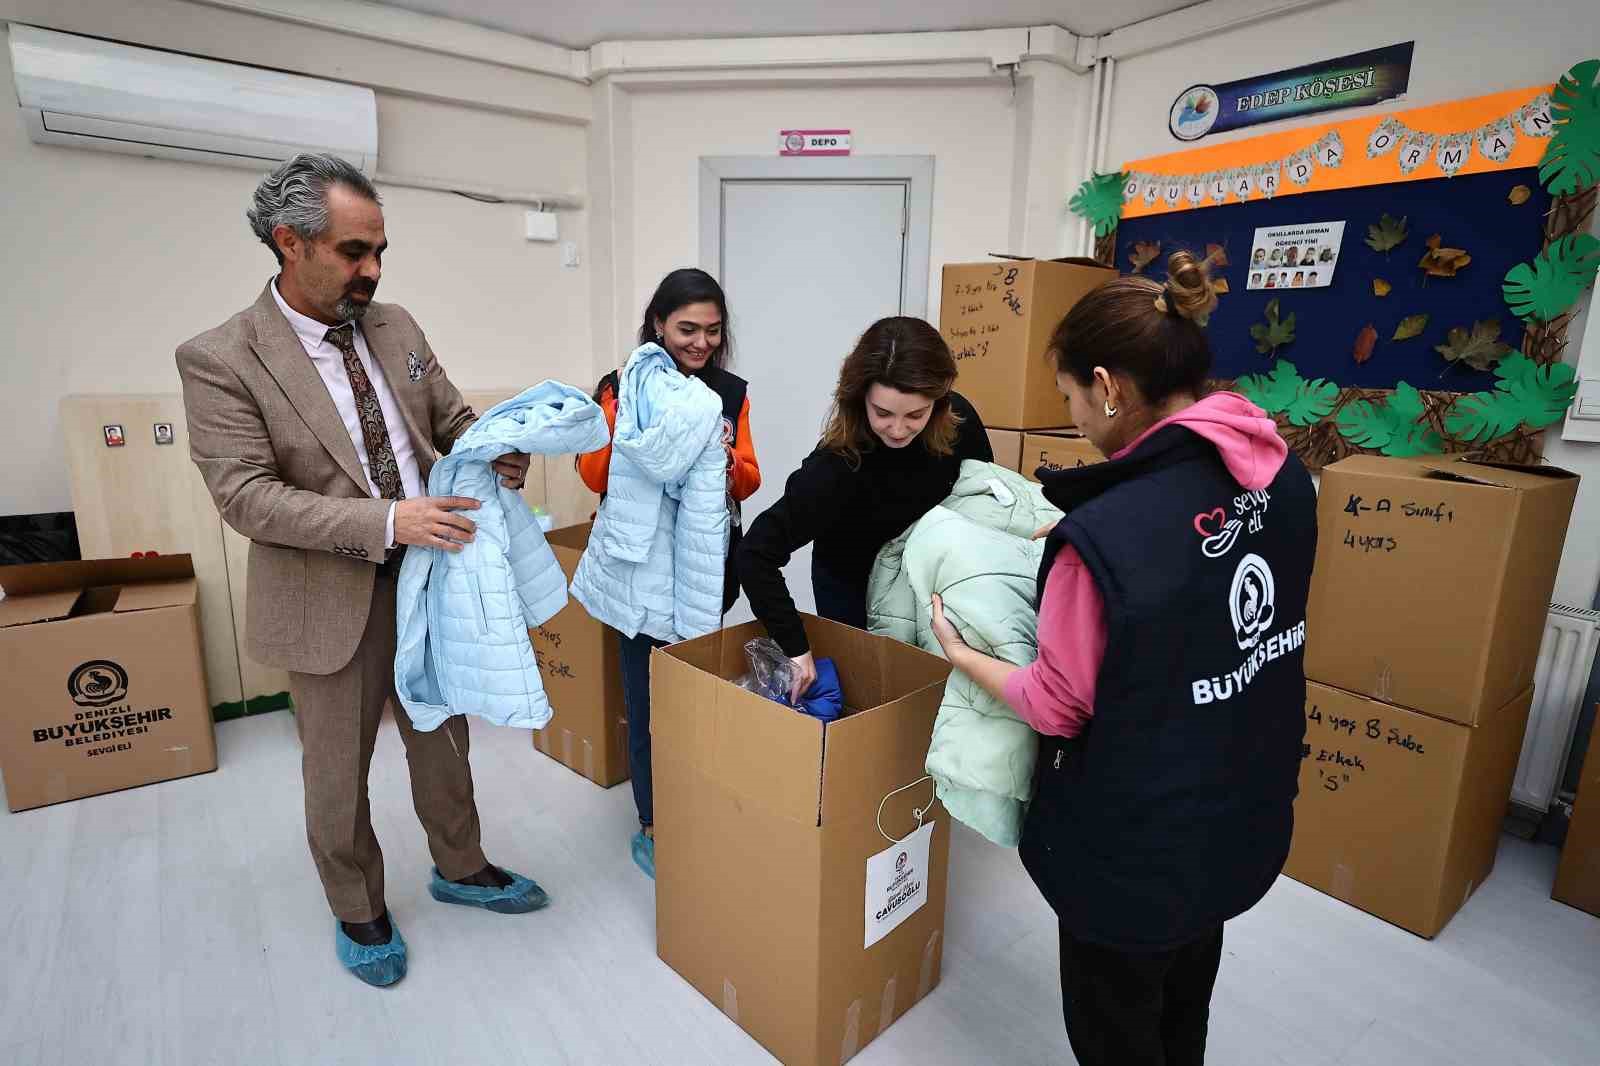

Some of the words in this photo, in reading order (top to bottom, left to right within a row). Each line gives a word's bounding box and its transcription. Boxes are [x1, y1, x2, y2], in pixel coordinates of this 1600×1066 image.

[1237, 88, 1290, 112] EDEP
[1295, 65, 1376, 102] KÖŞESİ
[811, 138, 837, 146] DEPO
[1127, 148, 1338, 200] OKULLARDA
[1375, 113, 1551, 166] ORMAN
[1267, 230, 1304, 238] OKULLARDA
[1305, 228, 1330, 236] ORMAN
[1004, 267, 1018, 285] B
[1248, 510, 1264, 534] eli
[1191, 620, 1305, 705] BÜYÜKŞEHİR
[1308, 705, 1322, 726] 4
[1366, 719, 1381, 739] B
